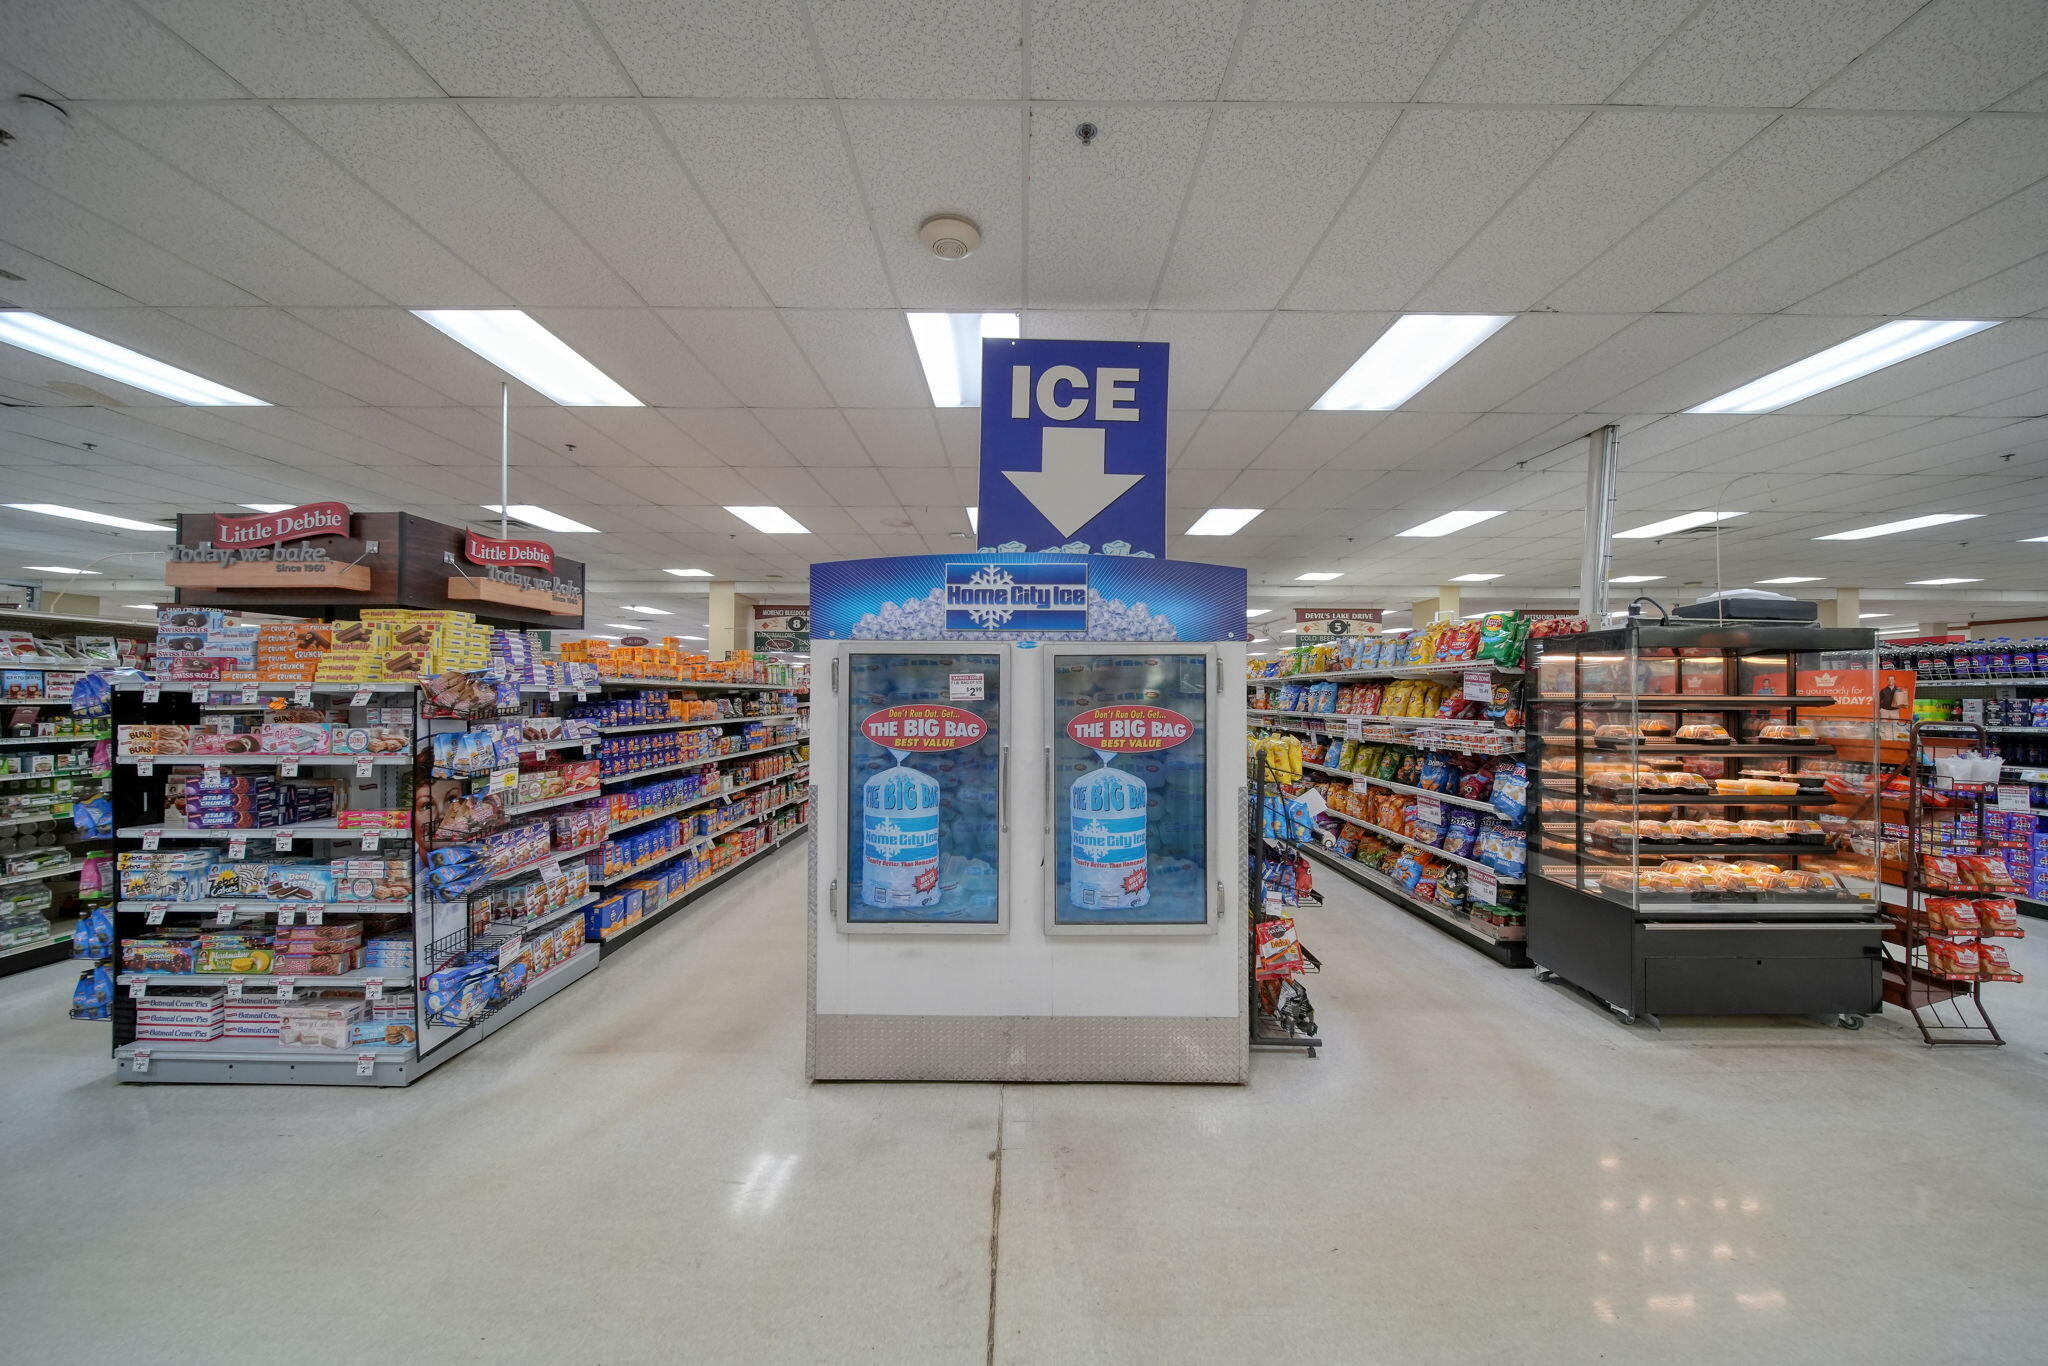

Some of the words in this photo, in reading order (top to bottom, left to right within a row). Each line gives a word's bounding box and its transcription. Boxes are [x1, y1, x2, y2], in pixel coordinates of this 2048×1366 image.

[1011, 365, 1140, 422] ICE
[219, 523, 272, 543] Little
[276, 509, 342, 535] Debbie
[167, 541, 237, 568] Today,
[241, 547, 270, 562] we
[470, 540, 507, 559] Little
[509, 546, 550, 563] Debbie
[276, 564, 301, 573] Since
[304, 564, 326, 573] 1960
[534, 579, 552, 591] we
[946, 586, 1008, 605] Home
[1010, 586, 1051, 609] City
[1053, 586, 1086, 605] Ice
[792, 619, 801, 629] 8
[1334, 623, 1342, 632] 5
[294, 651, 323, 659] CRUNCH
[172, 672, 194, 680] SWISS
[194, 672, 220, 680] ROLLS
[1805, 688, 1822, 696] you
[1823, 686, 1849, 696] ready
[1851, 686, 1865, 695] for
[888, 709, 907, 718] Don't
[909, 710, 922, 718] Run
[924, 709, 939, 718] Out.
[941, 709, 960, 718] Get...
[1094, 710, 1114, 719] Don't
[1115, 710, 1129, 719] Run
[1130, 710, 1145, 719] Out.
[1147, 710, 1167, 719] Get...
[273, 715, 294, 723] BUNS
[868, 721, 898, 737] THE
[904, 718, 940, 737] BIG
[945, 720, 980, 737] BAG
[1074, 721, 1104, 738] THE
[1110, 719, 1146, 738] BIG
[1151, 721, 1187, 738] BAG
[129, 730, 153, 740] BUNS
[349, 736, 366, 744] DONUT
[894, 738, 920, 747] BEST
[922, 738, 956, 747] VALUE
[1101, 739, 1126, 748] BEST
[1129, 739, 1163, 748] VALUE
[129, 745, 152, 754] BUNS
[884, 779, 918, 810] BIG
[1090, 780, 1125, 811] BIG
[865, 831, 898, 845] Home
[899, 834, 925, 847] City
[925, 832, 938, 843] Ice
[1073, 832, 1105, 847] Home
[1107, 835, 1132, 848] City
[288, 871, 310, 880] Devil
[208, 876, 239, 888] Zebra
[282, 880, 316, 889] Cremes
[211, 883, 239, 896] Cakes
[150, 999, 175, 1008] Oatmeal
[175, 999, 195, 1008] Creme
[194, 1000, 208, 1008] Pies
[150, 1014, 175, 1022] Oatmeal
[194, 1015, 209, 1023] Pies
[237, 1011, 262, 1019] Oatmeal
[149, 1029, 174, 1037] Oatmeal
[174, 1029, 194, 1037] Creme
[194, 1030, 207, 1038] Pies
[237, 1026, 262, 1034] Oatmeal
